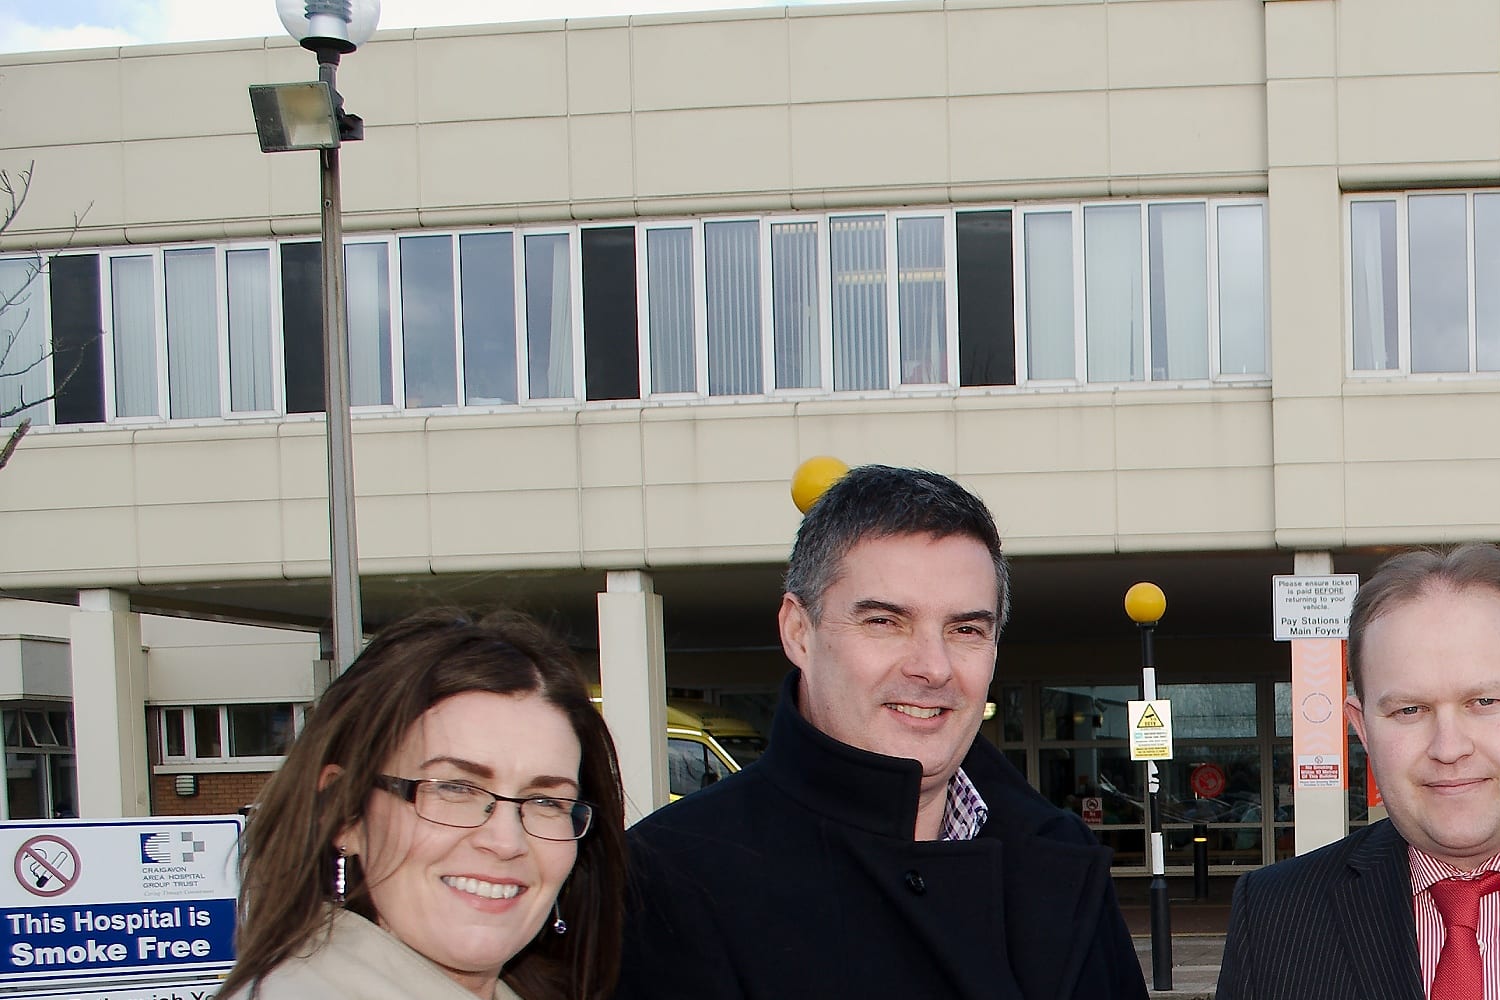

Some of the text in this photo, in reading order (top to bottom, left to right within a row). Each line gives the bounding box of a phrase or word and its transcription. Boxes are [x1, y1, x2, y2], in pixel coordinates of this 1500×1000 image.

[1281, 617, 1298, 626] Pay
[1301, 616, 1340, 625] Stations
[1290, 626, 1343, 636] Main Foyer.
[6, 906, 211, 935] This Hospital is
[11, 936, 211, 967] Smoke Free
